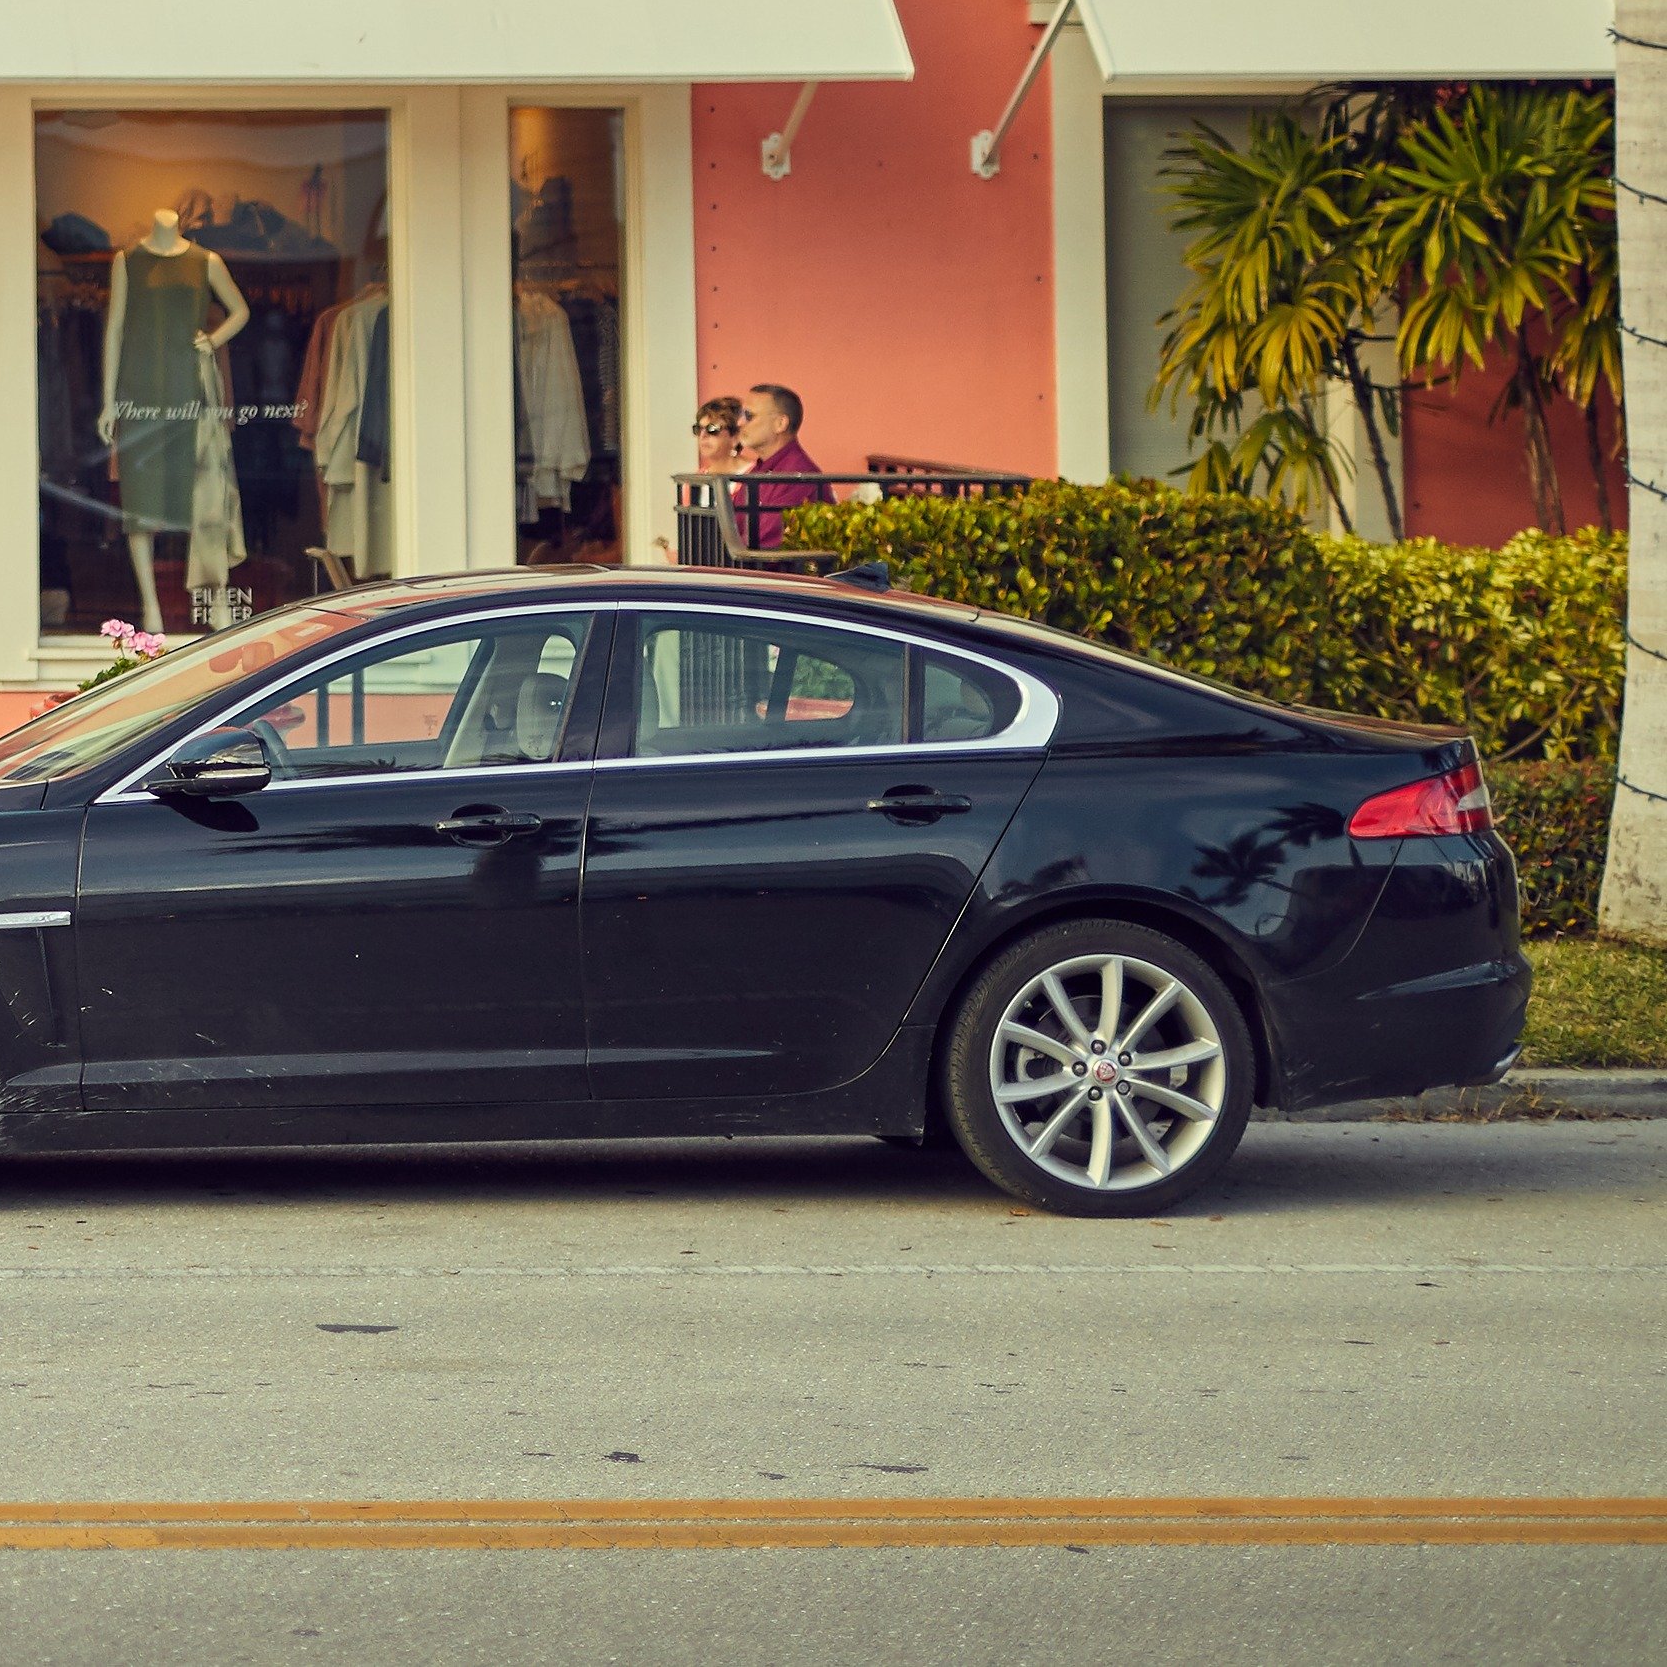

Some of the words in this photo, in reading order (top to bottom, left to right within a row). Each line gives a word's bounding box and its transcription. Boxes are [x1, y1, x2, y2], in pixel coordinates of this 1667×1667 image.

[165, 399, 201, 420] will
[204, 405, 233, 422] ou
[236, 404, 259, 425] go
[263, 399, 308, 418] next?
[192, 587, 252, 605] EILEN
[192, 606, 253, 624] FIER
